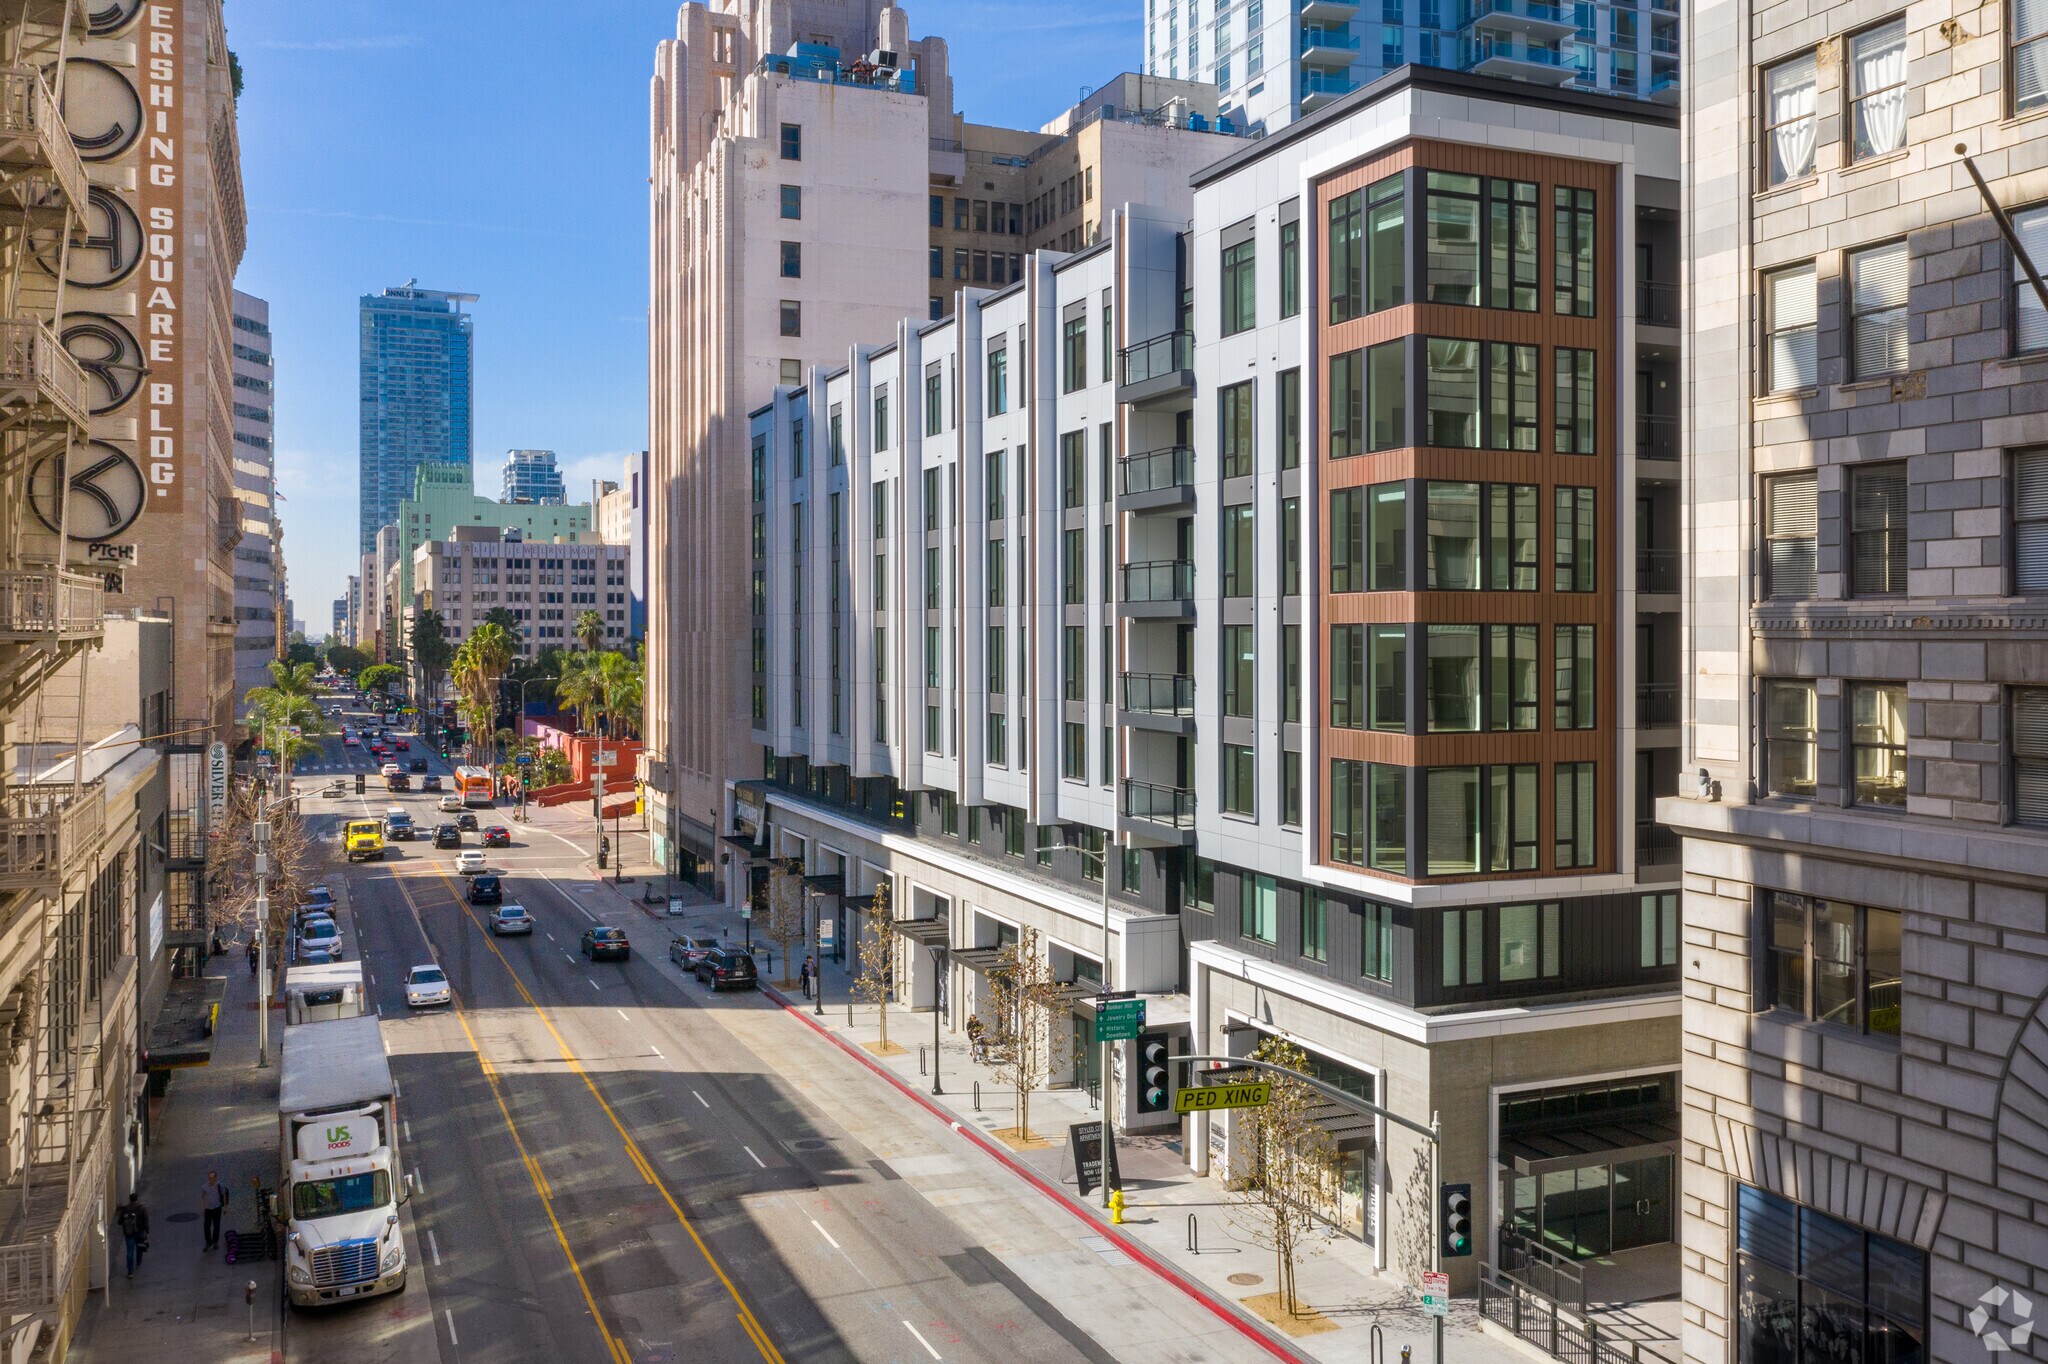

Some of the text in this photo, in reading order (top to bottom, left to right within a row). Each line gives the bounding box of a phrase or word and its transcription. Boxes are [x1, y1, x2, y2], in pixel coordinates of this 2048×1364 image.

[147, 207, 176, 362] SQUARE
[150, 383, 176, 497] BLDG.
[454, 545, 497, 553] CALIF
[507, 546, 563, 555] JEWELRY
[211, 760, 224, 800] SILVER
[1183, 1088, 1262, 1108] PED XING
[328, 1141, 351, 1149] FOODS
